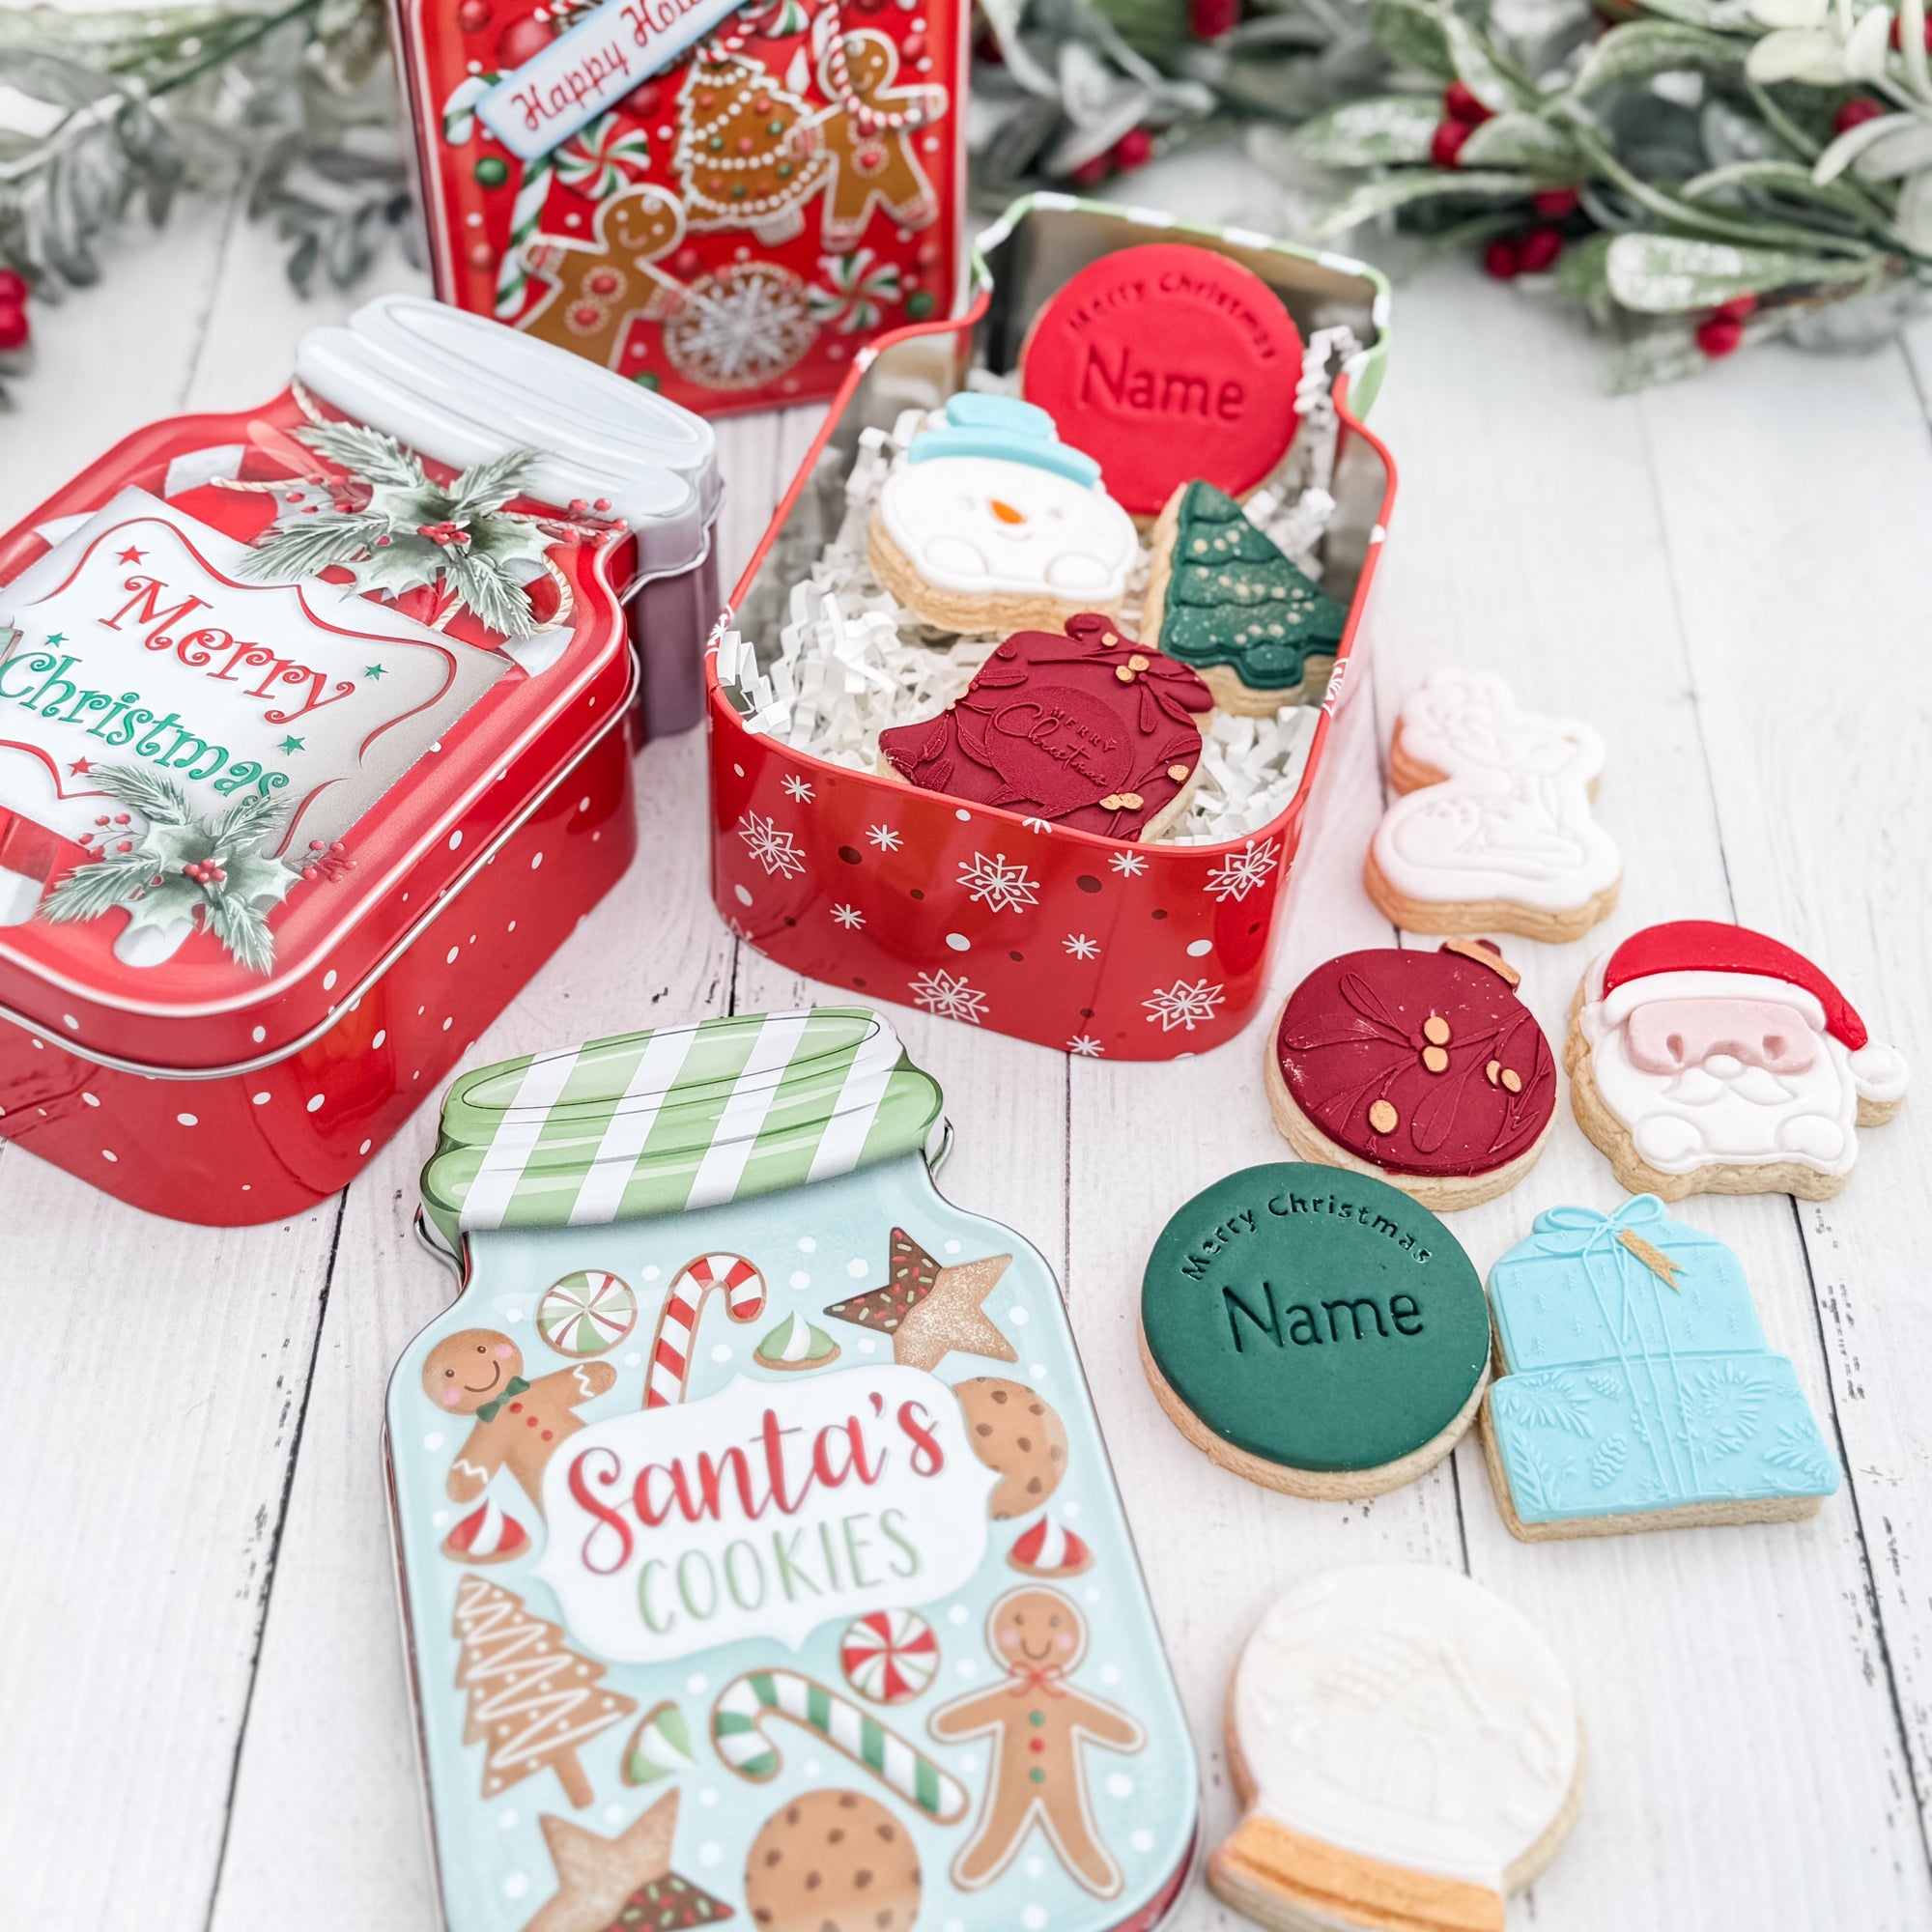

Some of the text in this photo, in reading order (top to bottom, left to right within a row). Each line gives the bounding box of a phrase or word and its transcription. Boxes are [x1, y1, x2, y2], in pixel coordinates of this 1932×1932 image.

[510, 42, 631, 130] Happy
[1068, 271, 1276, 360] Merry Christmas
[1080, 343, 1244, 421] Name
[98, 574, 356, 724] Merry
[0, 652, 291, 807] Christmas
[993, 701, 1109, 787] Christmas
[1050, 705, 1118, 753] MERRY
[1180, 1193, 1434, 1282] Merry Christmas
[1222, 1281, 1424, 1354] Name
[567, 1391, 945, 1577] Santa's
[636, 1507, 923, 1635] COOKIES
